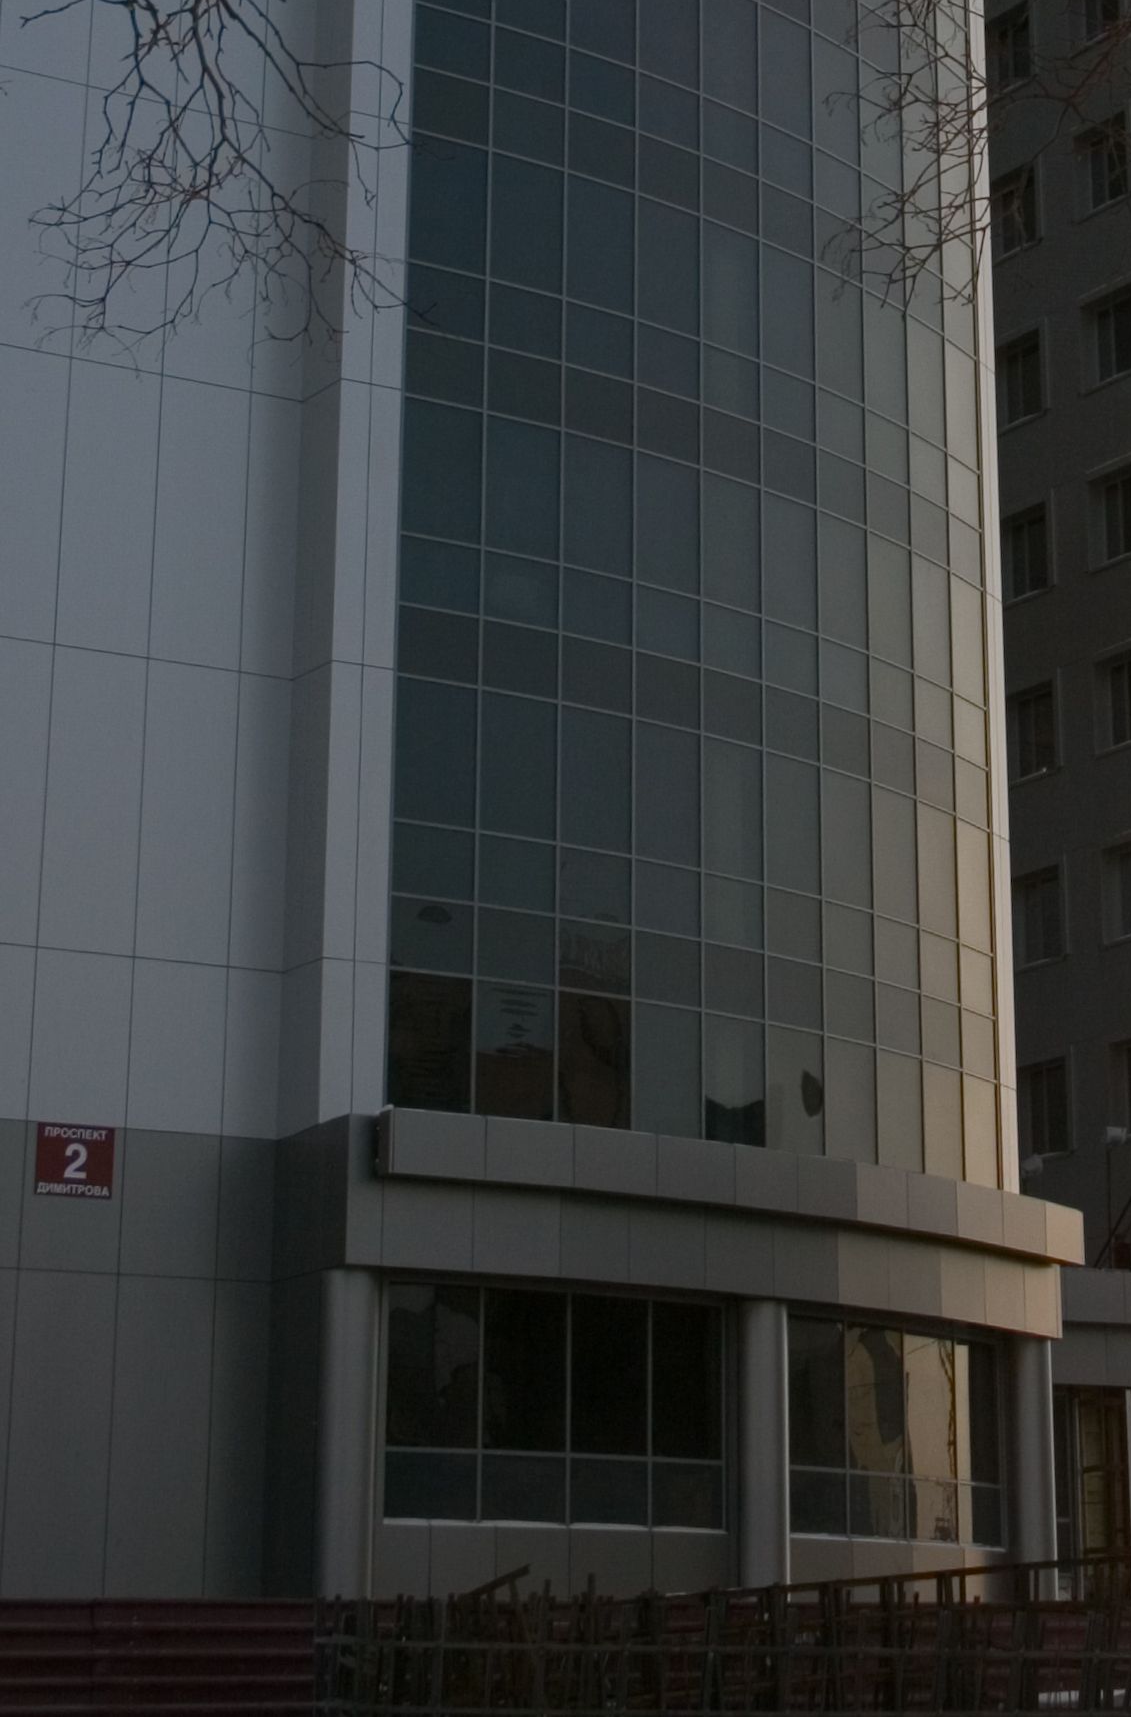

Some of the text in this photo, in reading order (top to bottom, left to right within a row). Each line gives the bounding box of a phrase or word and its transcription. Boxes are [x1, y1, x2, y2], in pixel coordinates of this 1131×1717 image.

[44, 1126, 108, 1141] ПРОСПЕКТ
[63, 1142, 88, 1179] 2
[37, 1181, 110, 1197] ДИМИТРОВА
